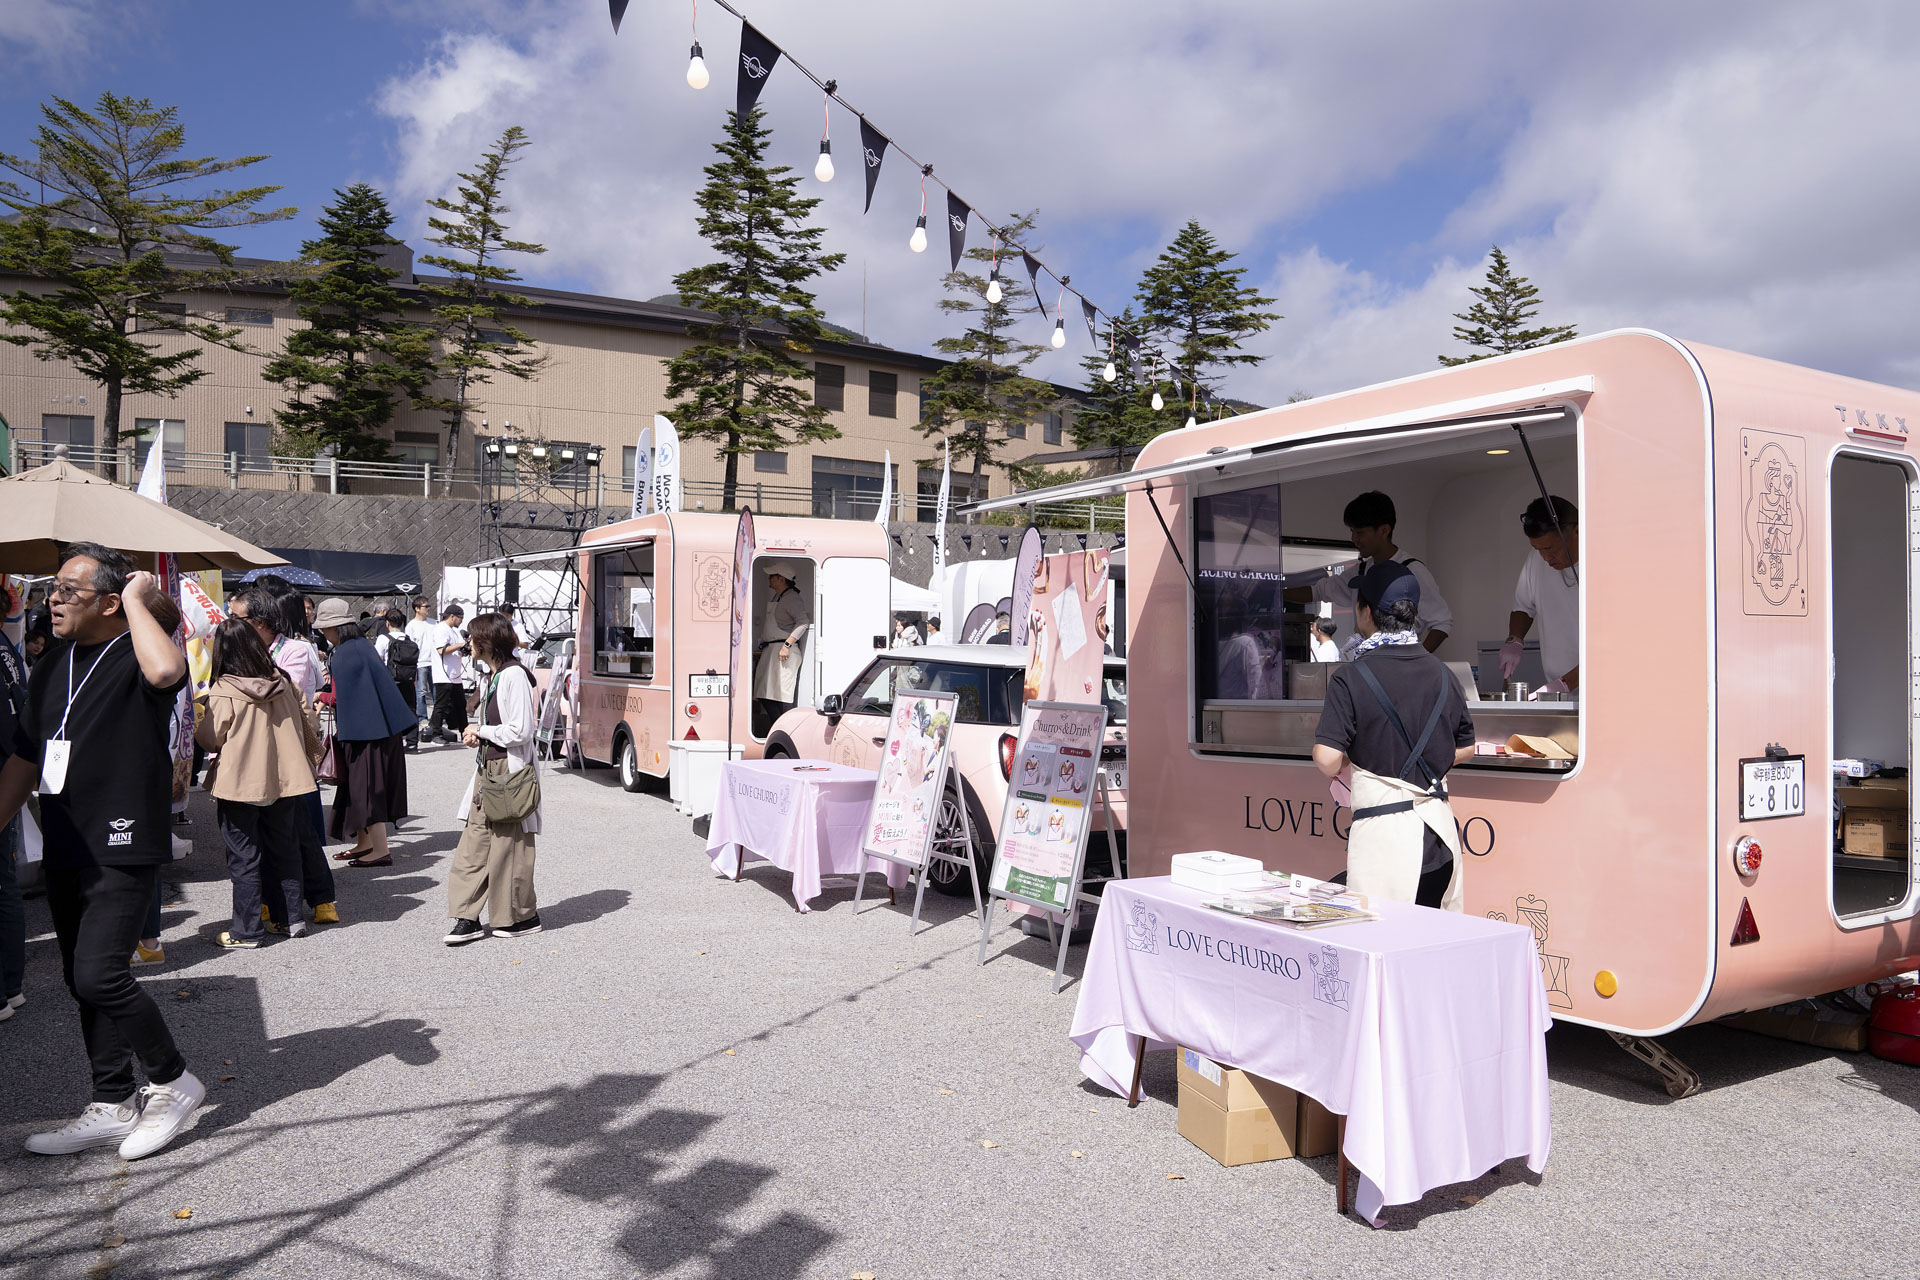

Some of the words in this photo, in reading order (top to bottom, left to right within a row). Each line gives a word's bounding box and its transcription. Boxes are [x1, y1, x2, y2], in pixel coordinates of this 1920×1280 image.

[636, 480, 646, 514] BMW
[1198, 569, 1237, 579] ACING
[738, 782, 753, 798] LOVE
[1243, 795, 1324, 838] LOVE
[108, 831, 133, 842] MINI
[1166, 926, 1214, 958] LOVE
[1217, 939, 1302, 981] CHURRO
